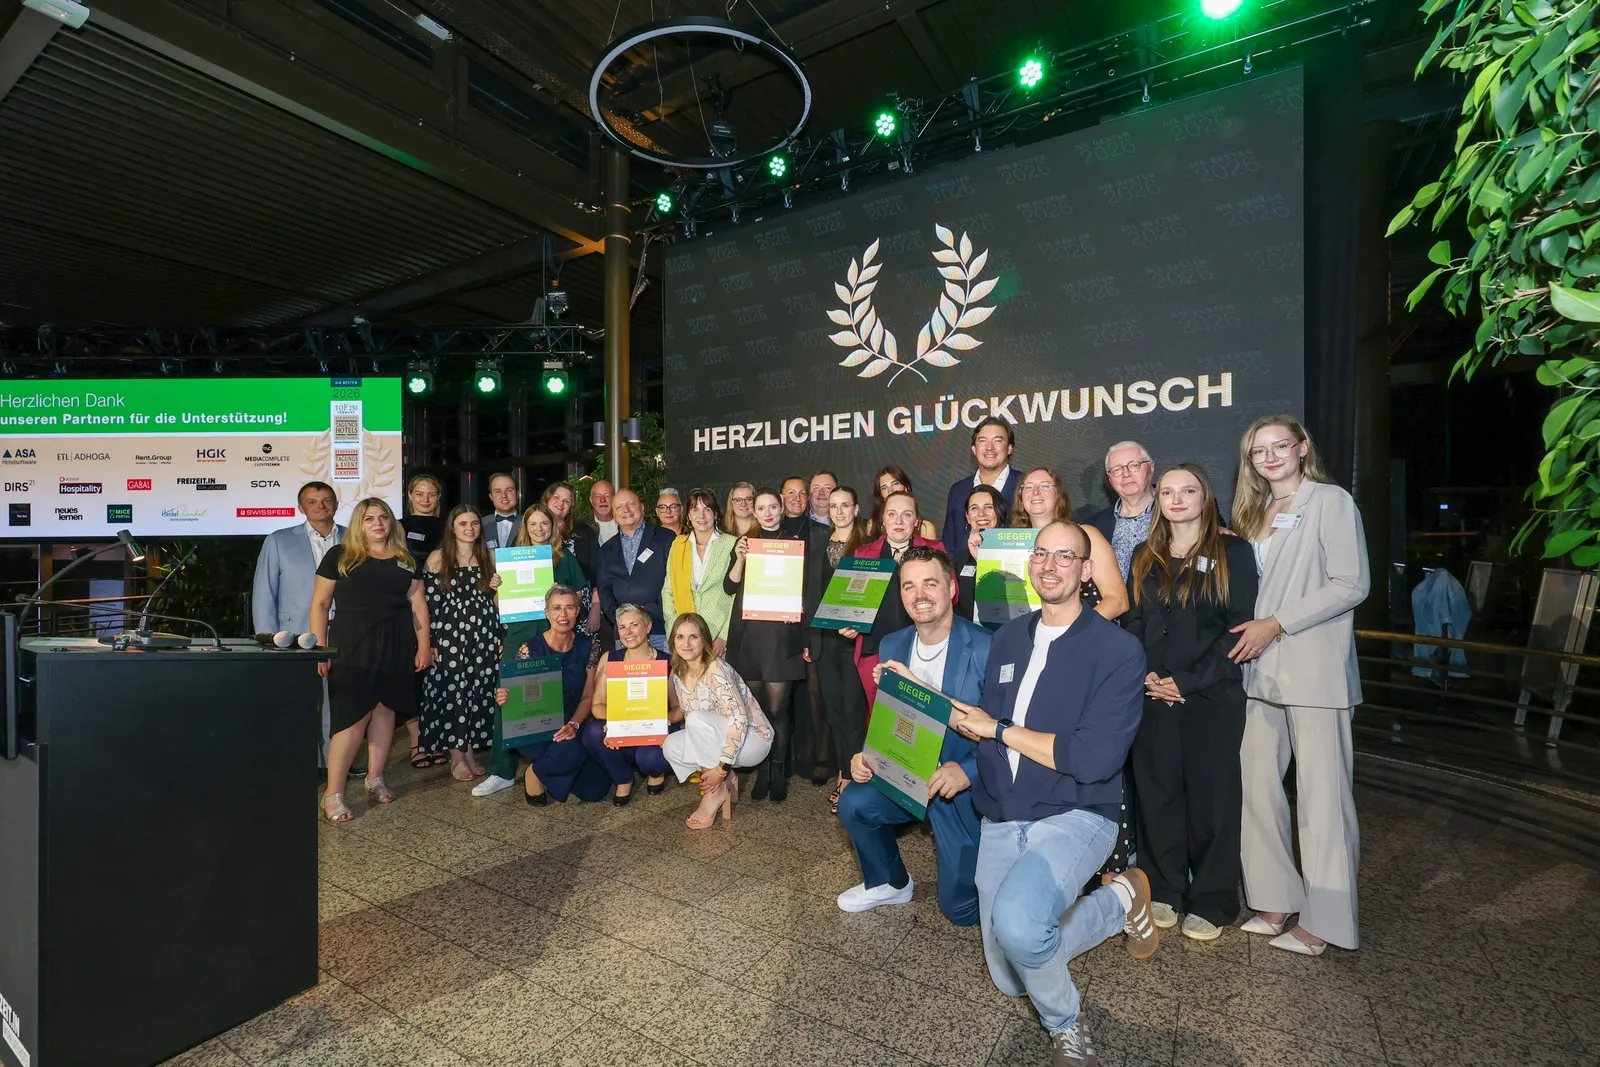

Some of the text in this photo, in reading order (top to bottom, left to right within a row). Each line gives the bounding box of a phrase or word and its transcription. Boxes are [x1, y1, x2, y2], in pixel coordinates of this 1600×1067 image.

[1169, 114, 1233, 142] 2026
[1080, 137, 1136, 165] 2026
[1002, 165, 1050, 187] 2026
[1199, 156, 1261, 184] 2026
[931, 184, 976, 204] 2026
[1103, 180, 1161, 205] 2026
[867, 201, 908, 222] 2026
[1022, 200, 1074, 224] 2026
[1223, 201, 1290, 228] 2026
[1126, 222, 1187, 247] 2026
[1155, 266, 1214, 290] 2026
[0, 393, 125, 408] Herzlichen Dank
[333, 388, 360, 398] 2026
[0, 412, 288, 425] unseren Partnern für die Unterstützung!
[694, 372, 1232, 452] HERZLICHEN GLÜCKWUNSCH
[15, 449, 36, 458] ASA
[197, 449, 226, 458] HGK
[5, 480, 35, 491] DIRS21
[61, 485, 100, 494] Hospitality
[998, 532, 1032, 540] SIEGER
[517, 660, 546, 669] SIEGER
[898, 680, 931, 704] SIEGER
